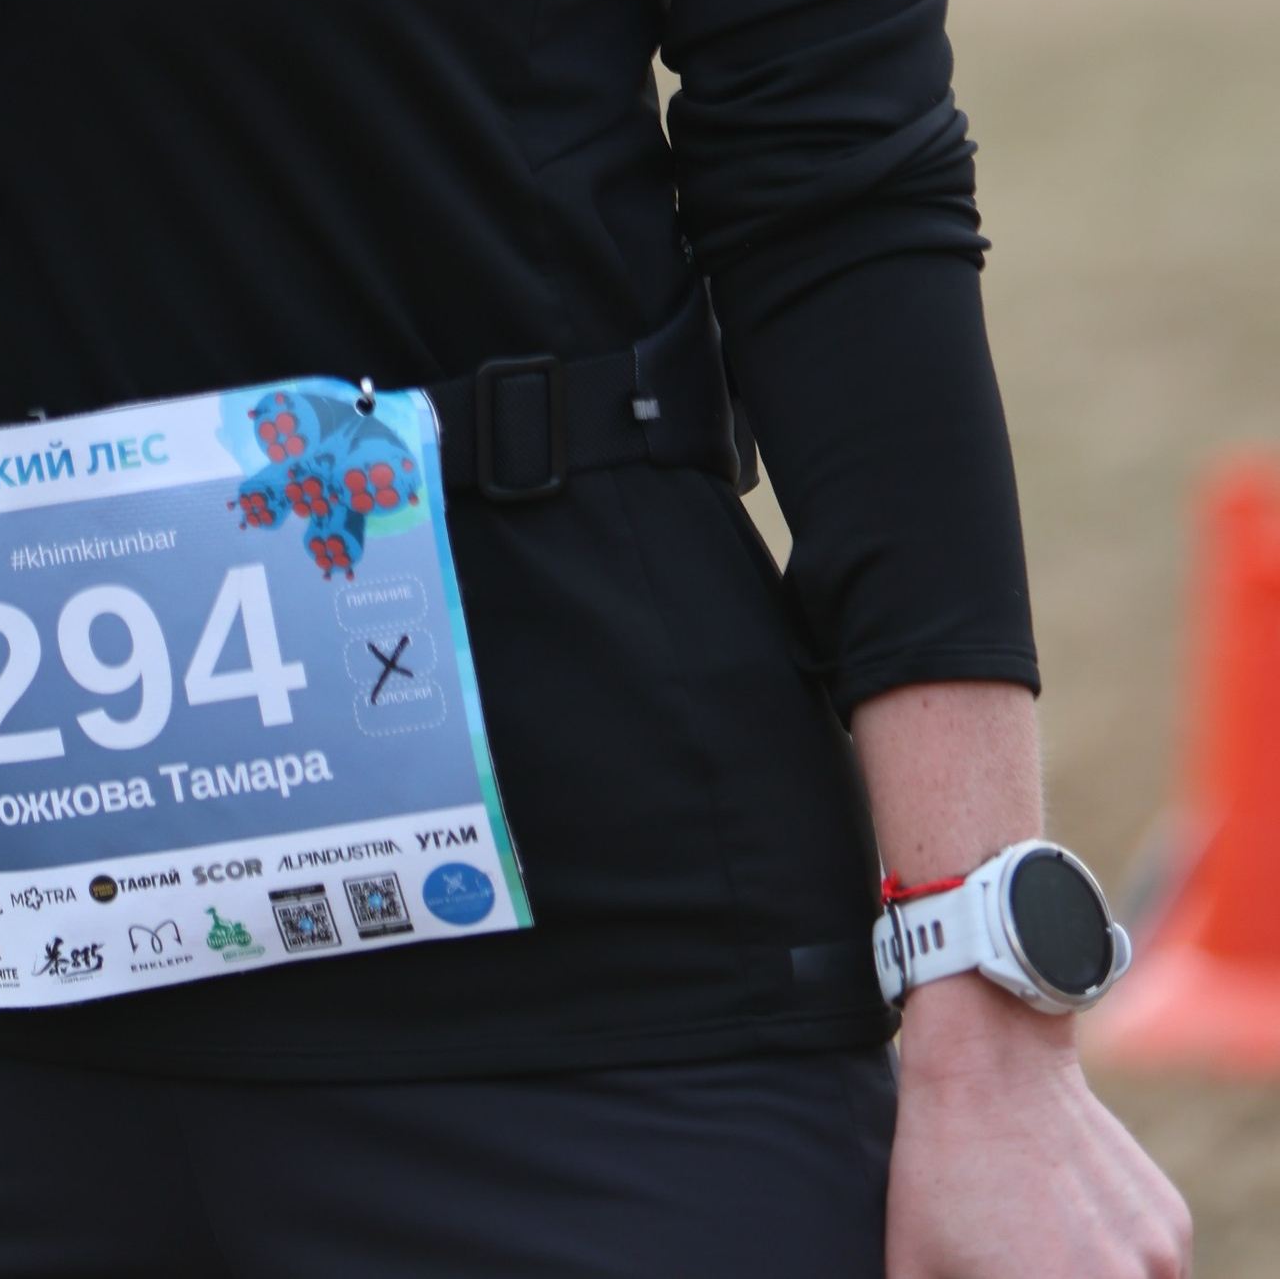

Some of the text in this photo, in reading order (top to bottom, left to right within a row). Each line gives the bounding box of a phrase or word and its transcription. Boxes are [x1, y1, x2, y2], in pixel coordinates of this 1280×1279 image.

[86, 432, 171, 476] ЛЕС
[10, 528, 178, 572] #khimkirunbar
[346, 587, 414, 608] ПИТАНИЕ
[158, 749, 334, 799] Тамара
[277, 838, 404, 872] ALPINDUSTRIA
[117, 869, 182, 893] ТАФГАЙ
[192, 858, 263, 887] SCOR
